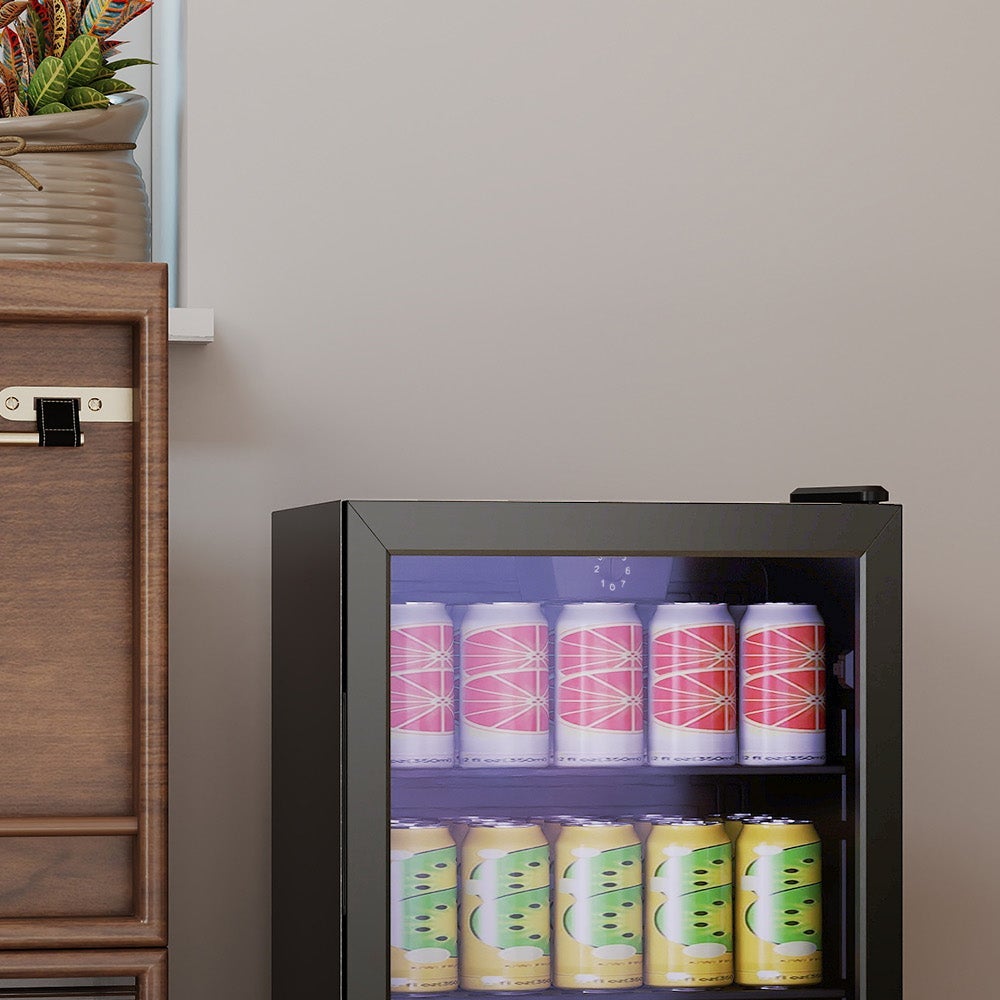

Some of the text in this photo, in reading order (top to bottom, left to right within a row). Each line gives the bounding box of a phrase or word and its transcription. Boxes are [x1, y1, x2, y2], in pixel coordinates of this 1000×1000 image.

[593, 565, 600, 574] 2
[625, 567, 631, 575] 6
[600, 579, 605, 588] 1
[609, 583, 616, 591] 0
[620, 580, 626, 588] 7
